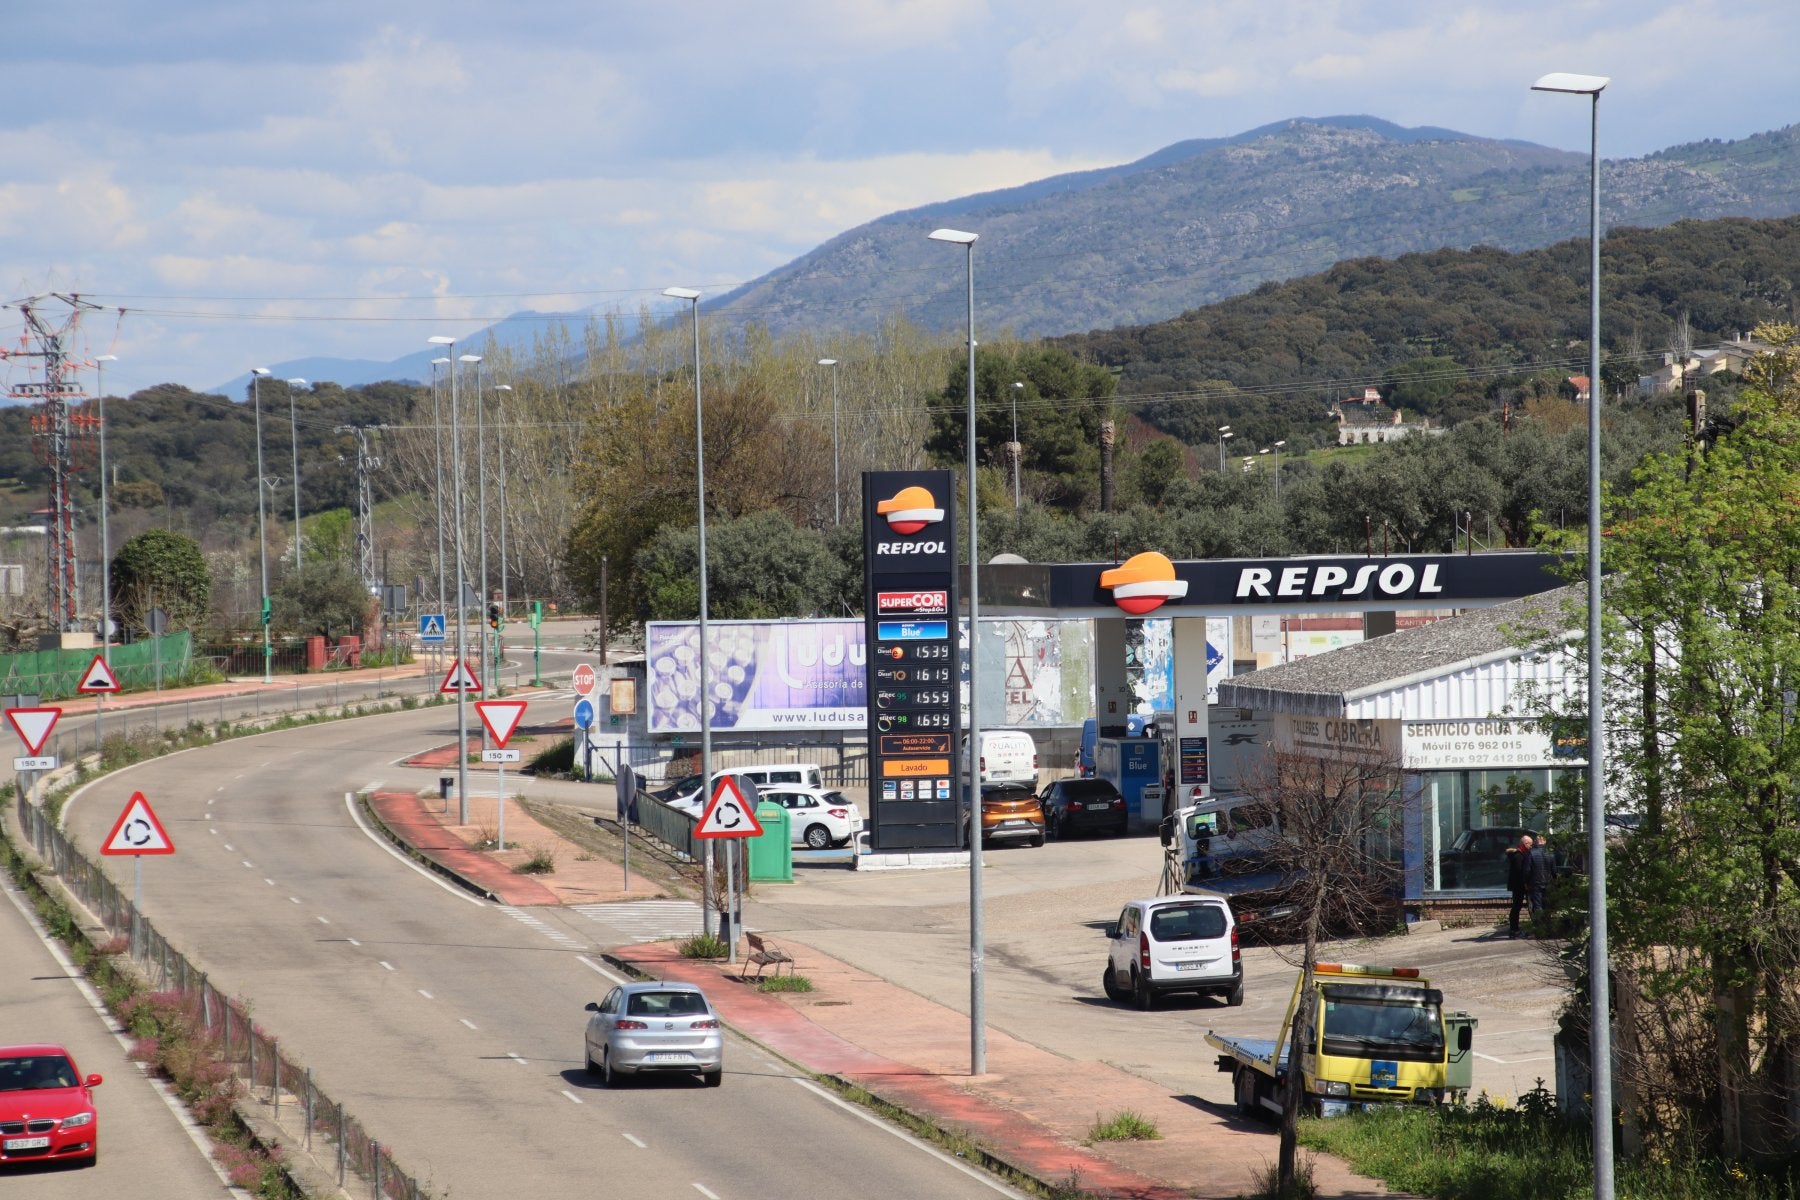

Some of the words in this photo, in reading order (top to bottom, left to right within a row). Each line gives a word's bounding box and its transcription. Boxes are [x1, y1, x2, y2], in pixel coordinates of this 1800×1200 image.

[877, 542, 946, 554] REPSOL
[1236, 563, 1442, 597] REPSOL
[902, 628, 920, 637] Blue
[916, 646, 948, 658] 1.539
[575, 675, 594, 685] STOP
[916, 668, 949, 680] 1.619
[851, 680, 863, 688] de
[917, 691, 950, 704] 1.559
[918, 714, 950, 726] 1.699
[1408, 723, 1470, 737] SERVICIO
[1422, 742, 1450, 750] Móvil
[1454, 742, 1474, 750] 676
[1478, 742, 1498, 750] 962
[1502, 741, 1522, 749] 015
[1445, 756, 1464, 764] Fax
[1468, 754, 1489, 762] 927
[1517, 754, 1538, 762] 809
[1129, 762, 1147, 770] Blue
